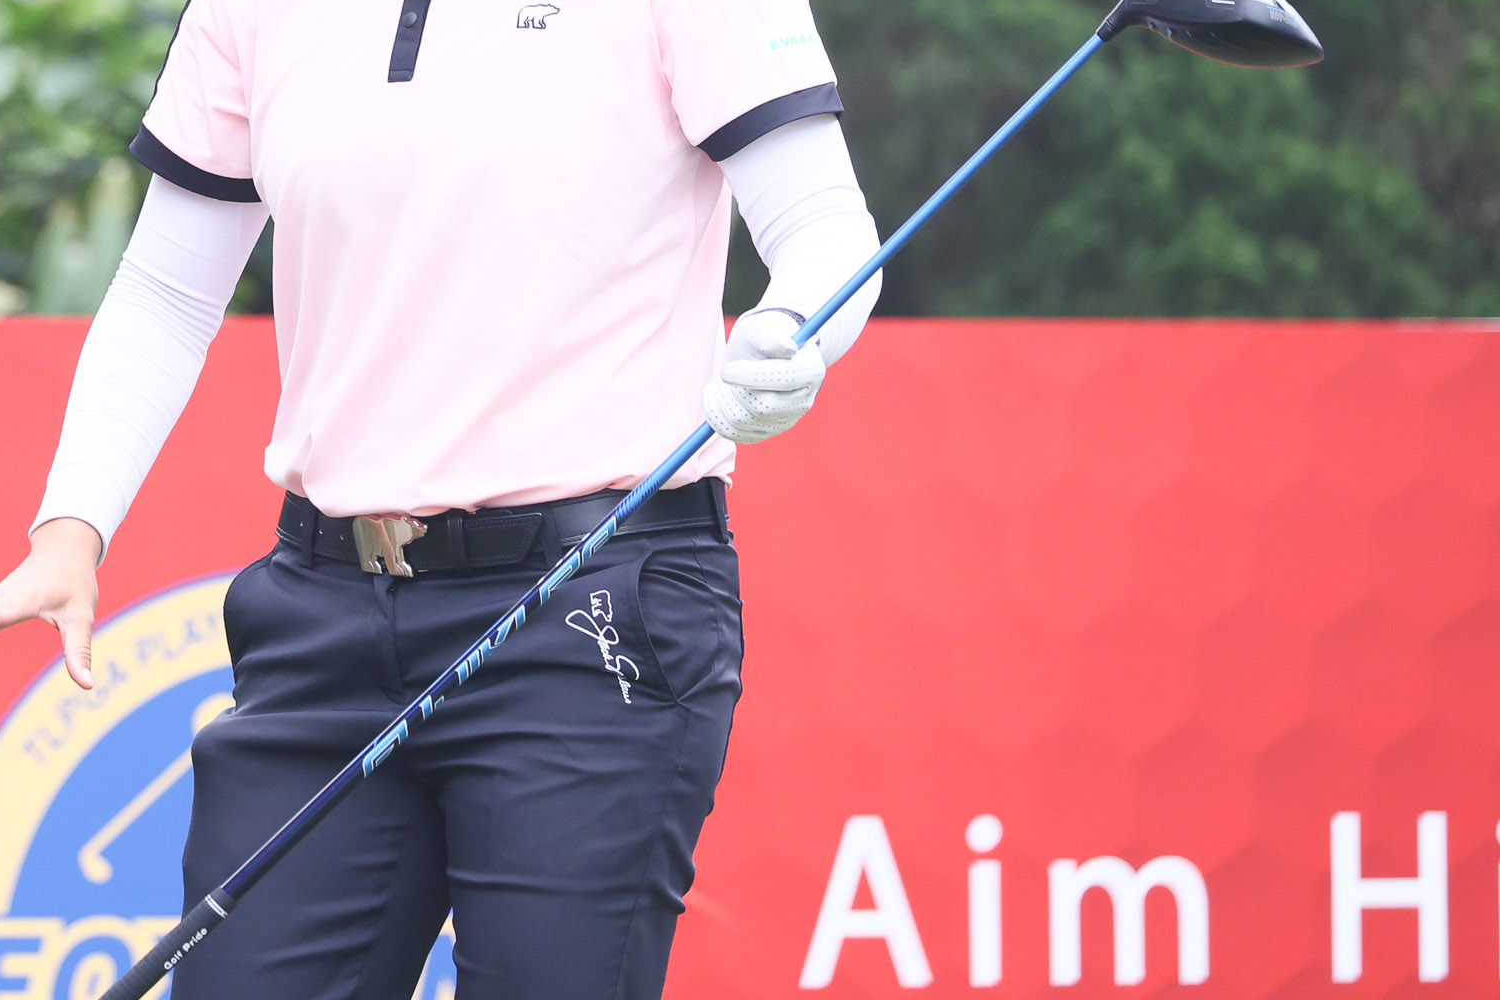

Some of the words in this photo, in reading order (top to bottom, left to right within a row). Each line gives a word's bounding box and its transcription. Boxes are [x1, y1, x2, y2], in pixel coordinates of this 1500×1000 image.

[163, 950, 183, 970] Golf
[182, 927, 208, 953] Pride
[799, 814, 1211, 989] Aim
[1330, 811, 1500, 984] H
